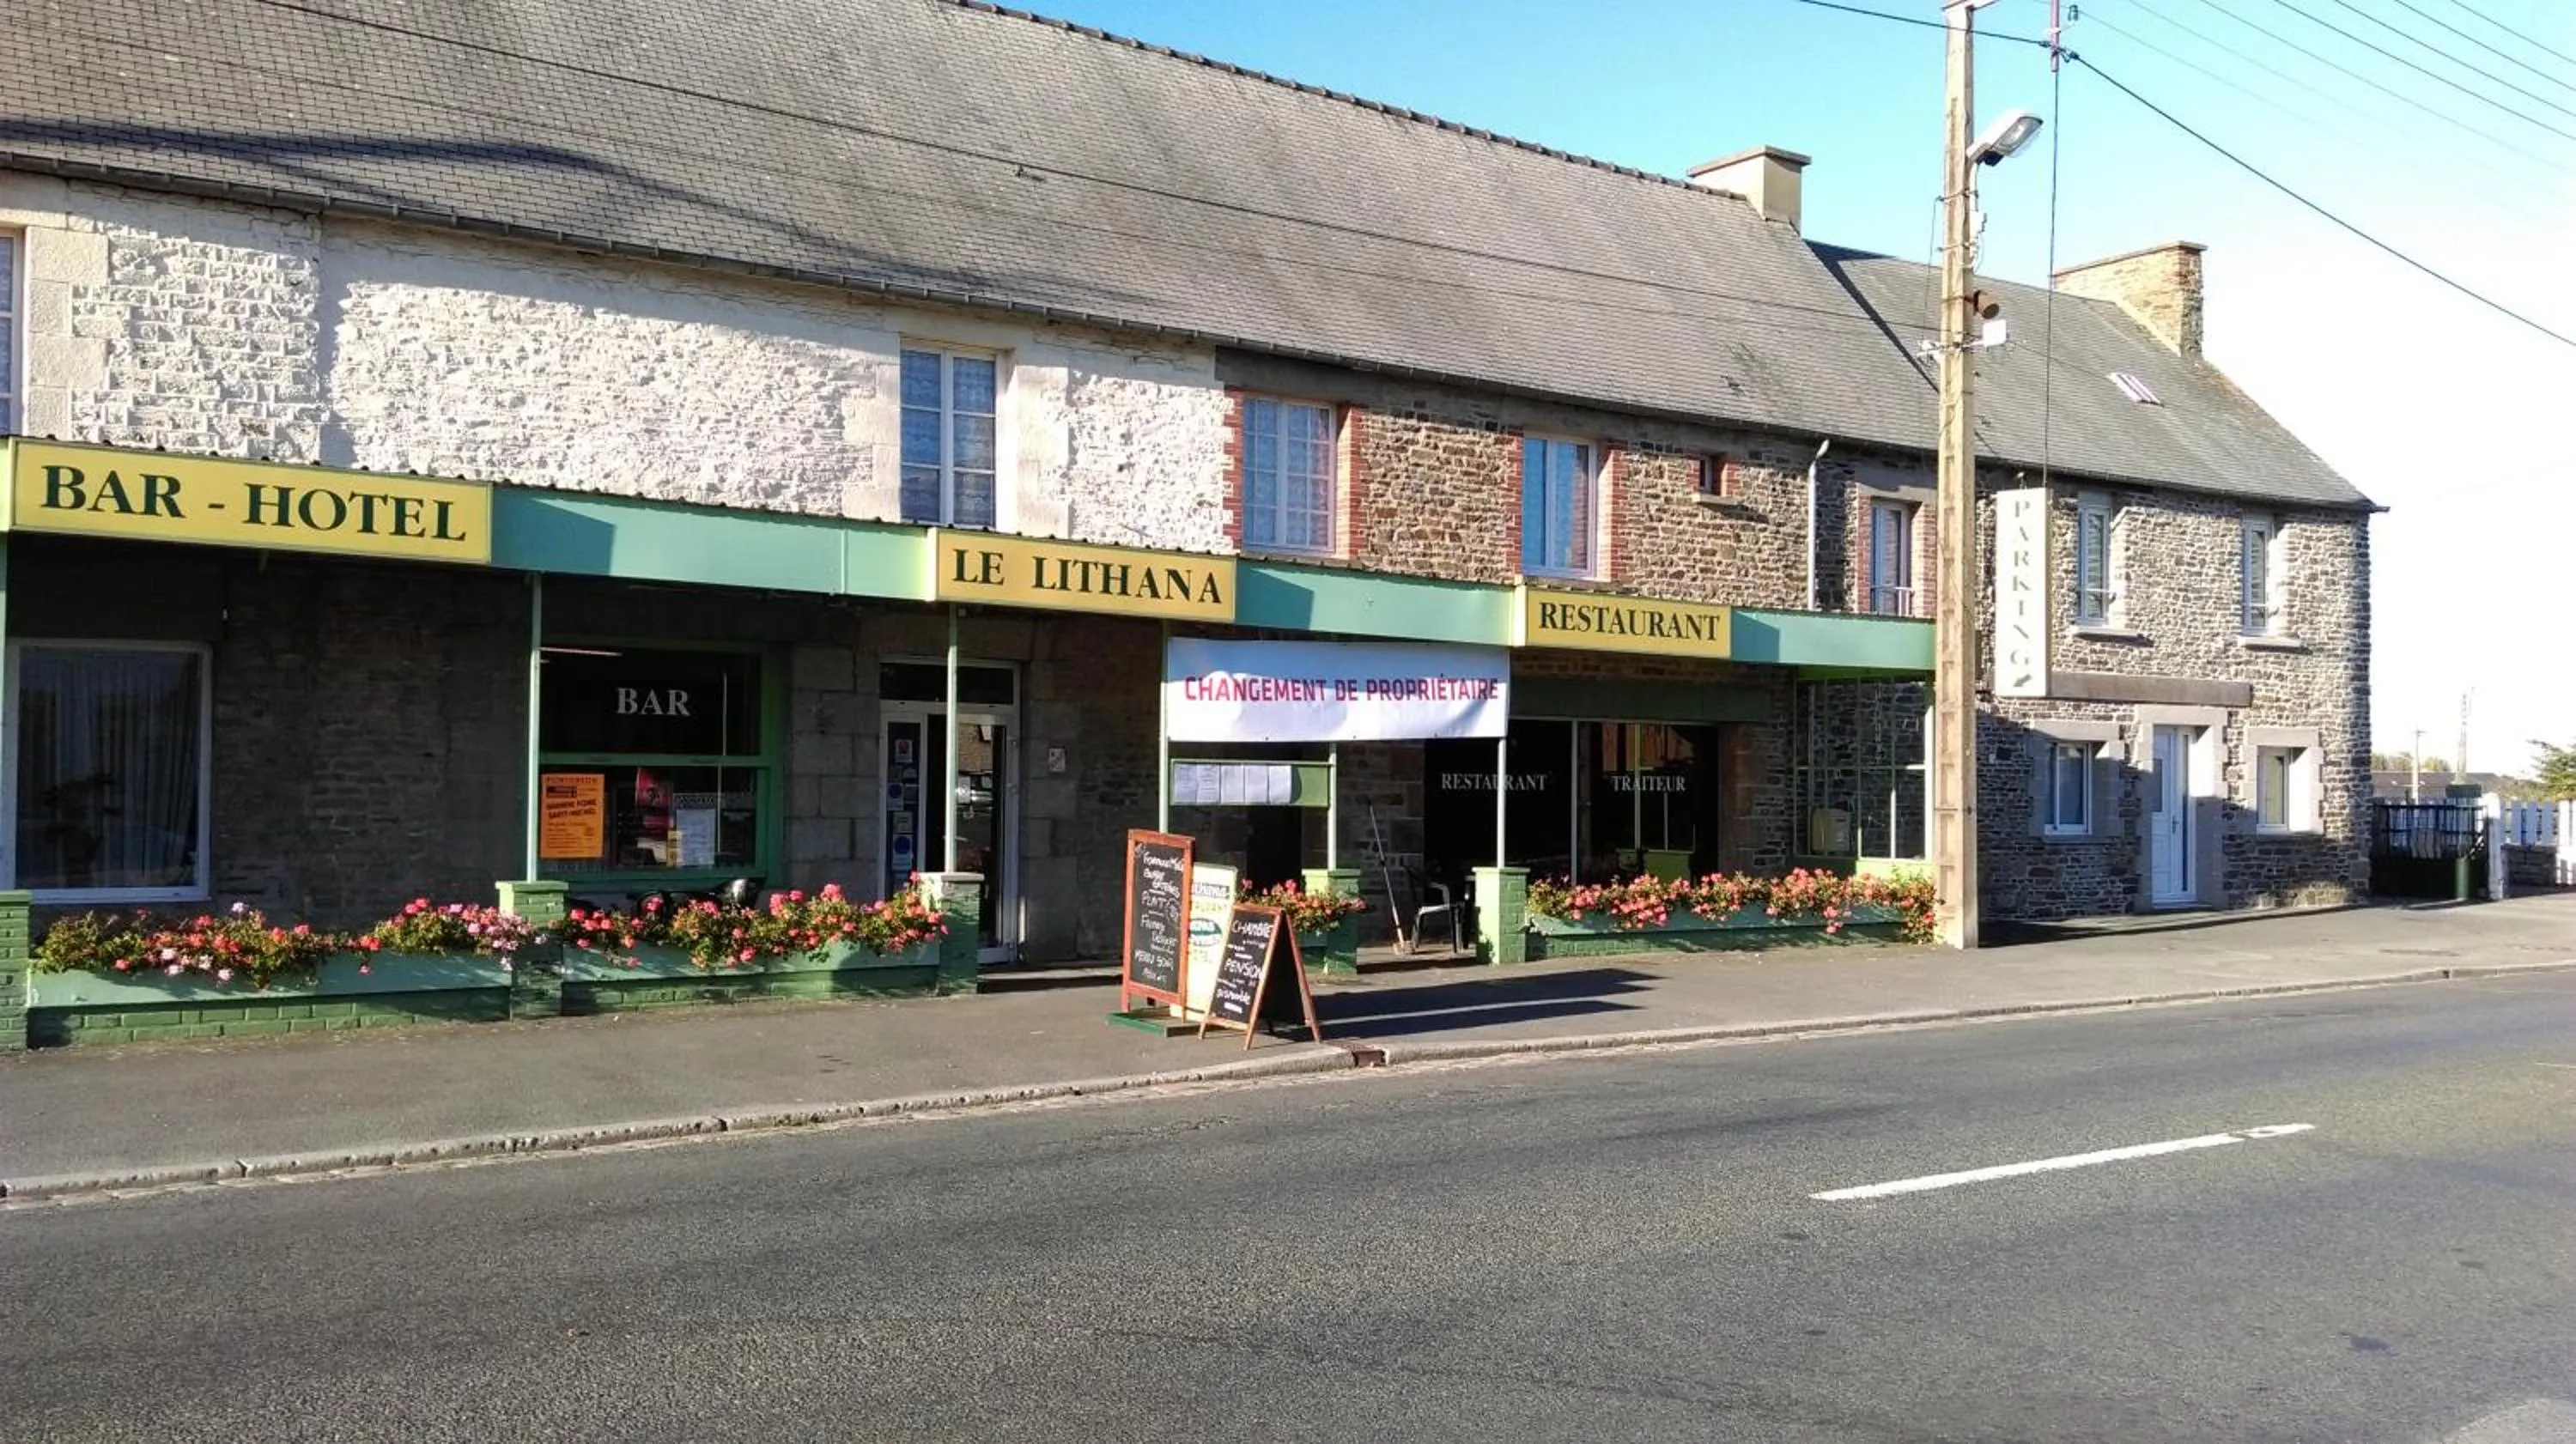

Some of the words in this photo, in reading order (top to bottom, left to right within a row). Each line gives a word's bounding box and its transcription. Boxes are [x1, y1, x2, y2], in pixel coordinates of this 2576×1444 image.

[41, 464, 186, 519] BAR
[243, 482, 466, 542] HOTEL
[952, 548, 1005, 586] LE
[1032, 555, 1223, 604] LITHANA
[1538, 601, 1721, 641] RESTAURANT
[617, 687, 691, 716] BAR
[1184, 676, 1327, 701] CHANGEMENT
[1335, 679, 1358, 701] DE
[1366, 673, 1499, 701] PROPRIÉTAIRE
[1611, 774, 1686, 792] TRAITEUR
